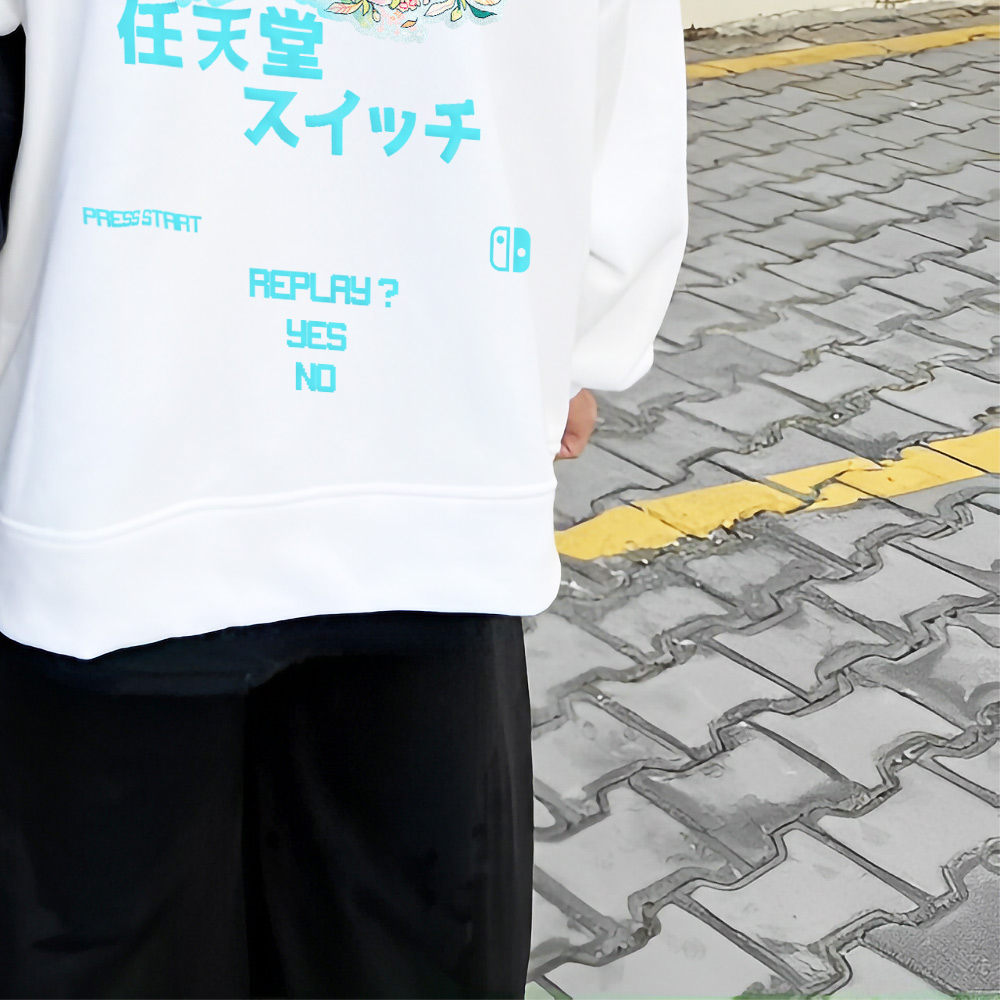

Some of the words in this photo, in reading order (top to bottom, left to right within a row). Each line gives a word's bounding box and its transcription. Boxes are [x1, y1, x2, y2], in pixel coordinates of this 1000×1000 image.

[243, 86, 482, 165] スイッチ
[82, 206, 140, 228] PRESS
[141, 209, 202, 233] START
[286, 318, 348, 352] YES
[295, 361, 337, 393] NO
